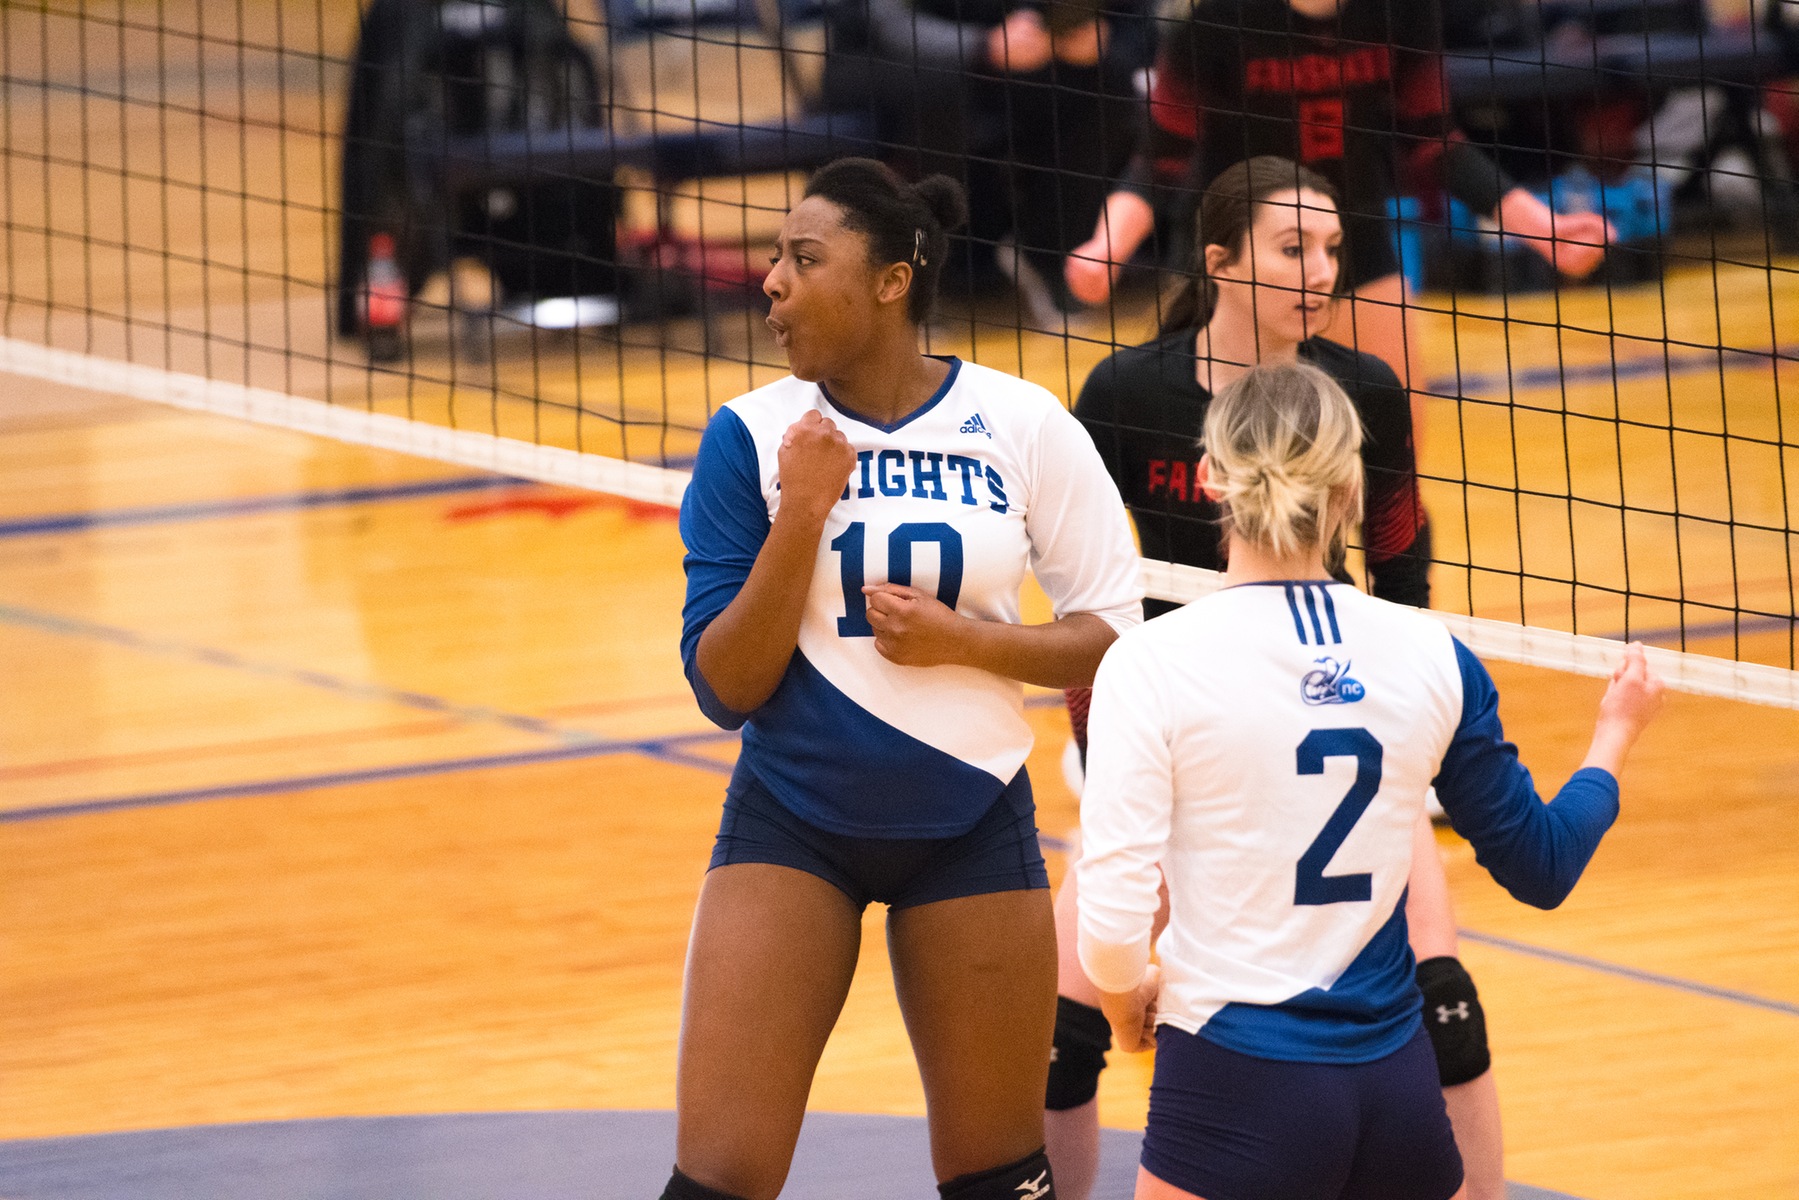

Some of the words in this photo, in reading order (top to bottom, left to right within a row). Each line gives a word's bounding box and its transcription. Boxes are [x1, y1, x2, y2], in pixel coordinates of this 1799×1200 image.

[777, 449, 1009, 514] IGHTS
[830, 521, 963, 637] 10
[1294, 727, 1383, 906] 2
